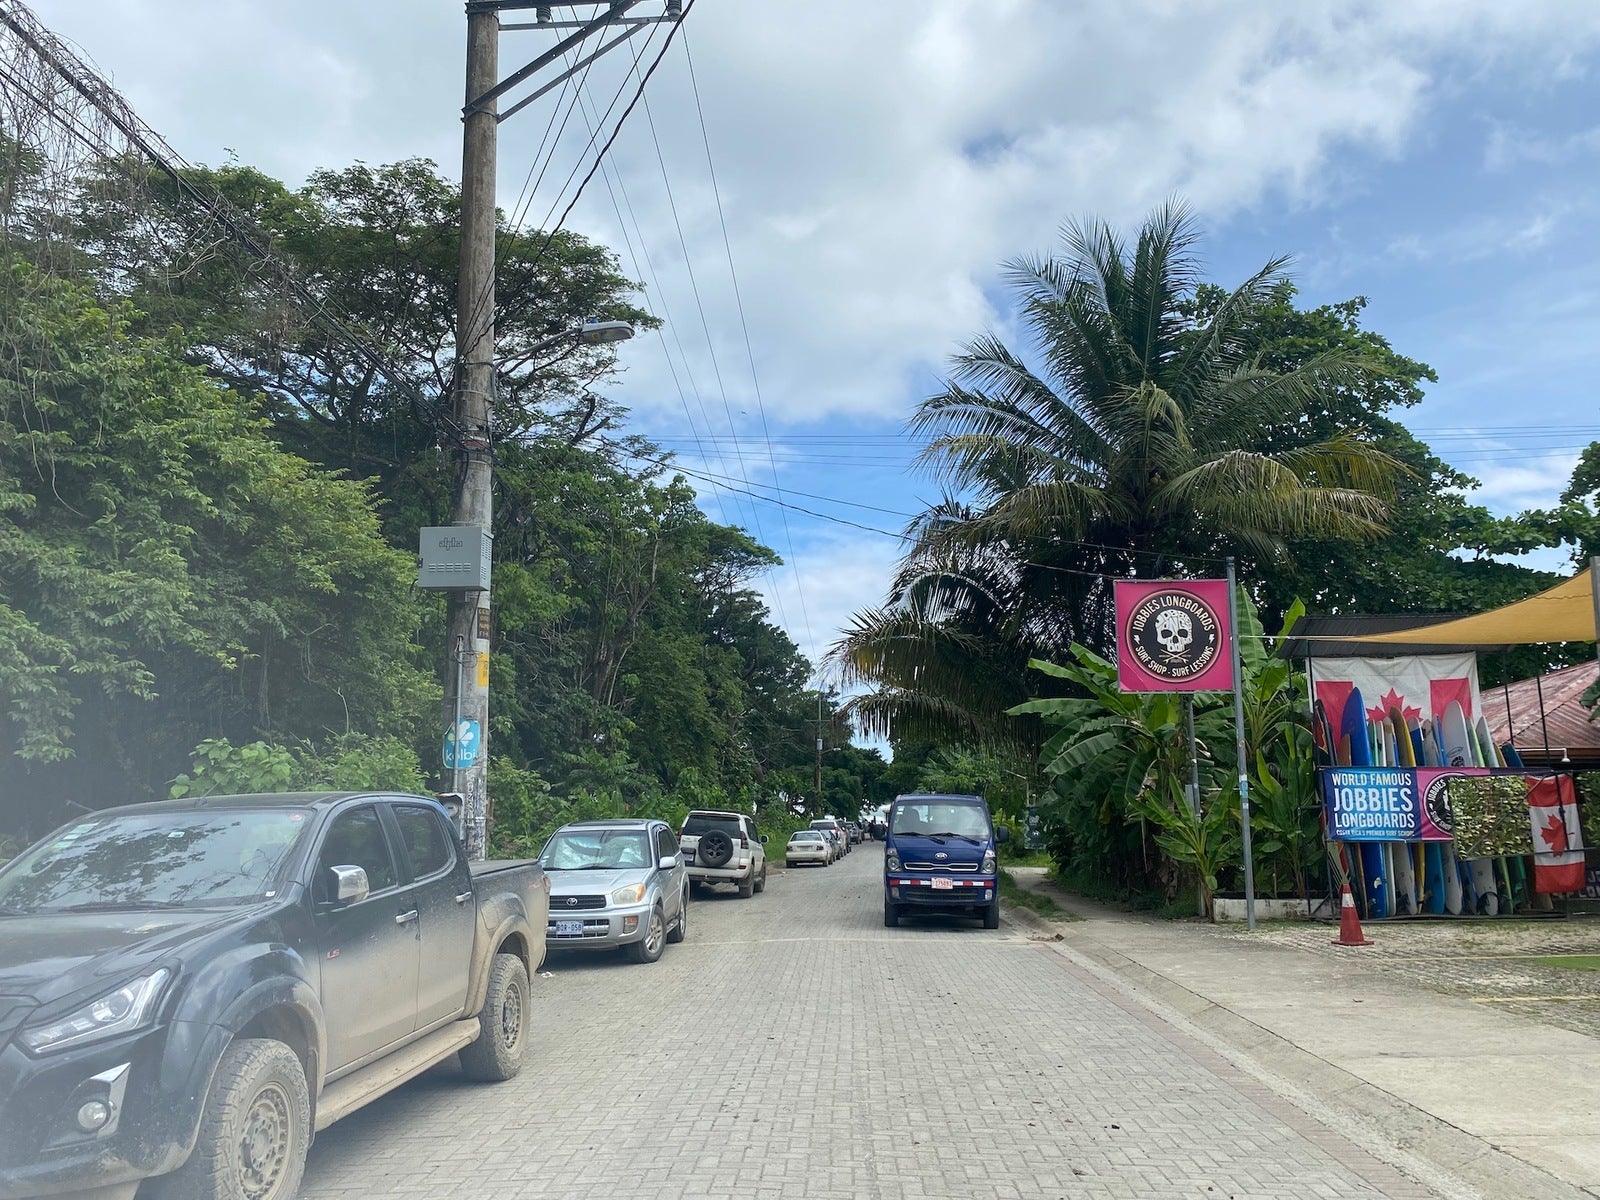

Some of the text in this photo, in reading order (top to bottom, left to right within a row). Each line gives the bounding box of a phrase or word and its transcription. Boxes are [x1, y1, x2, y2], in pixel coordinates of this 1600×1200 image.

[1132, 595, 1215, 632] JOBBIES LONGBOARDS
[1135, 645, 1152, 663] SURF
[1148, 660, 1168, 675] SHOP
[1171, 666, 1190, 677] SURF
[1189, 645, 1214, 673] LESSONS
[1331, 772, 1412, 786] WORLD FAMOUS
[1427, 778, 1447, 802] JOBBIES
[1333, 787, 1414, 812] JOBBIES
[1334, 812, 1415, 828] LONGBOARDS
[1429, 810, 1442, 823] SURF
